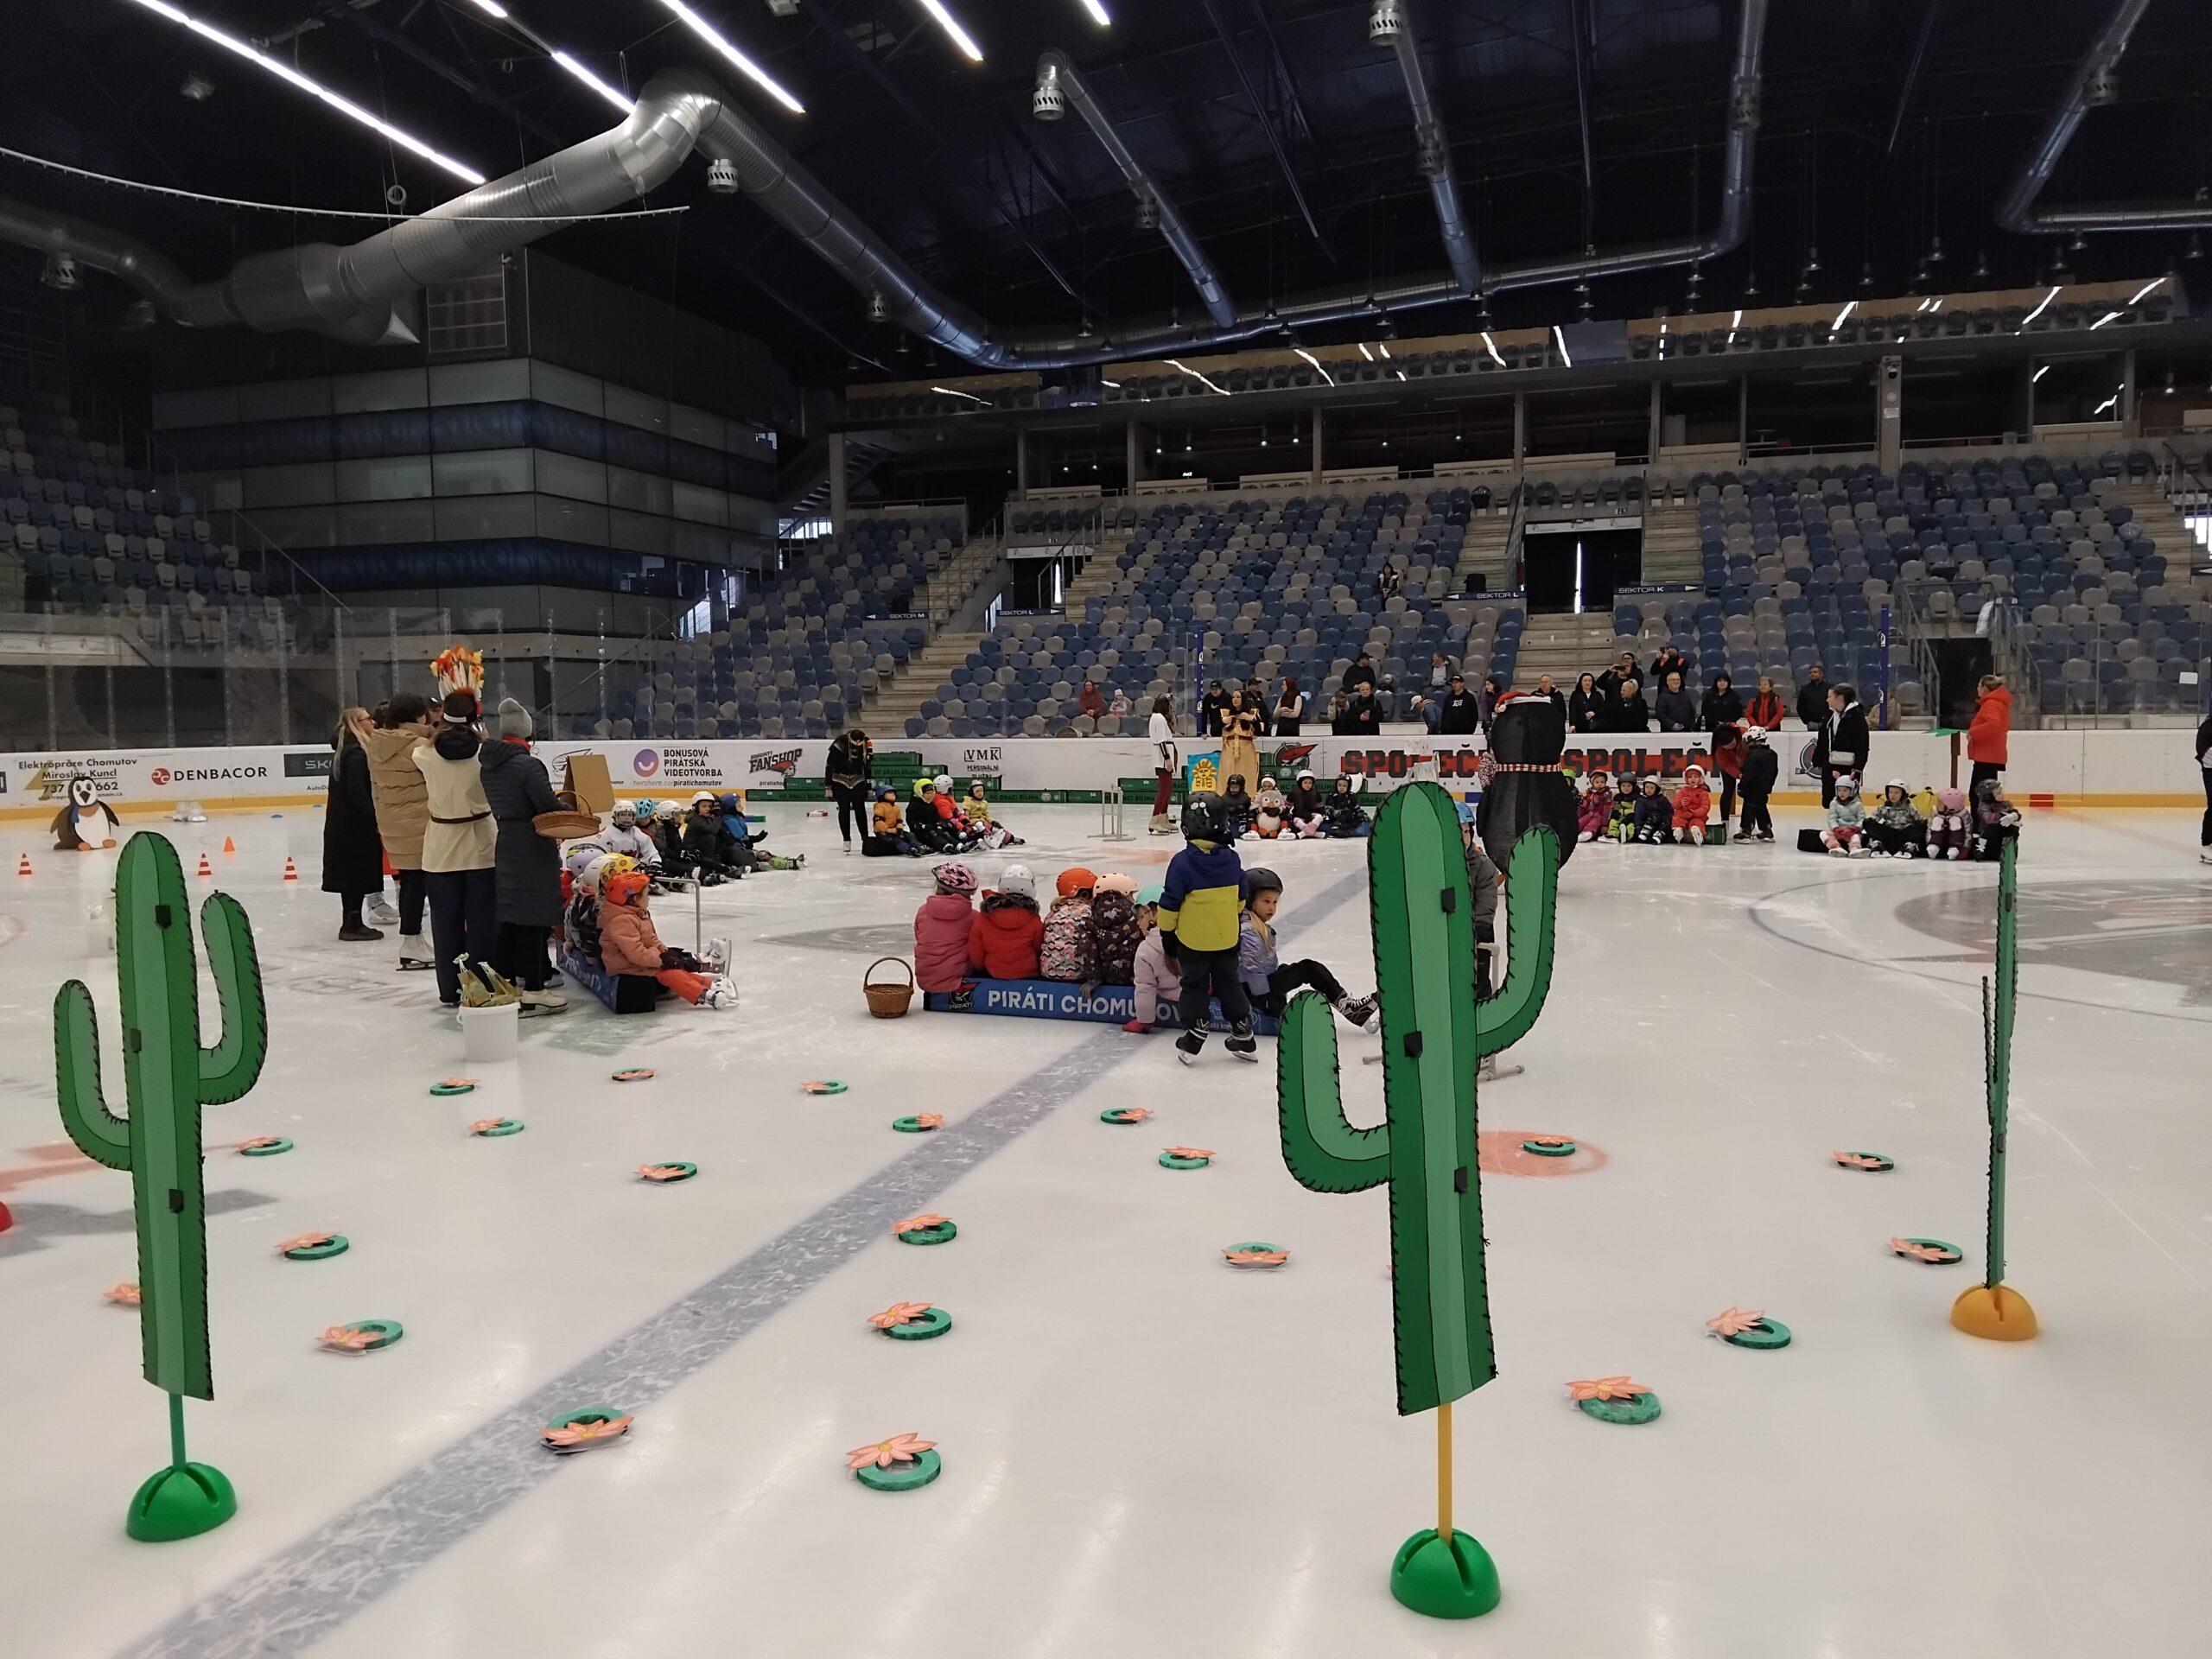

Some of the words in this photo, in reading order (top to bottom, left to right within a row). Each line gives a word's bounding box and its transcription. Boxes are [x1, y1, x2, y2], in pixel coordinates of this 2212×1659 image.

[664, 747, 709, 758] BONUSOVÁ
[966, 749, 999, 760] VMK
[86, 758, 137, 766] Chomutov
[664, 757, 706, 766] PIRÁTSKÁ
[748, 748, 803, 773] FANSHOP
[42, 769, 86, 779] Miroslav
[89, 768, 117, 777] Kuncl
[174, 766, 268, 781] DENBACOR
[664, 768, 723, 777] VIDEOTVORBA
[42, 784, 65, 794] 737
[95, 782, 118, 791] 662
[988, 986, 1054, 1011] PIRÁTI
